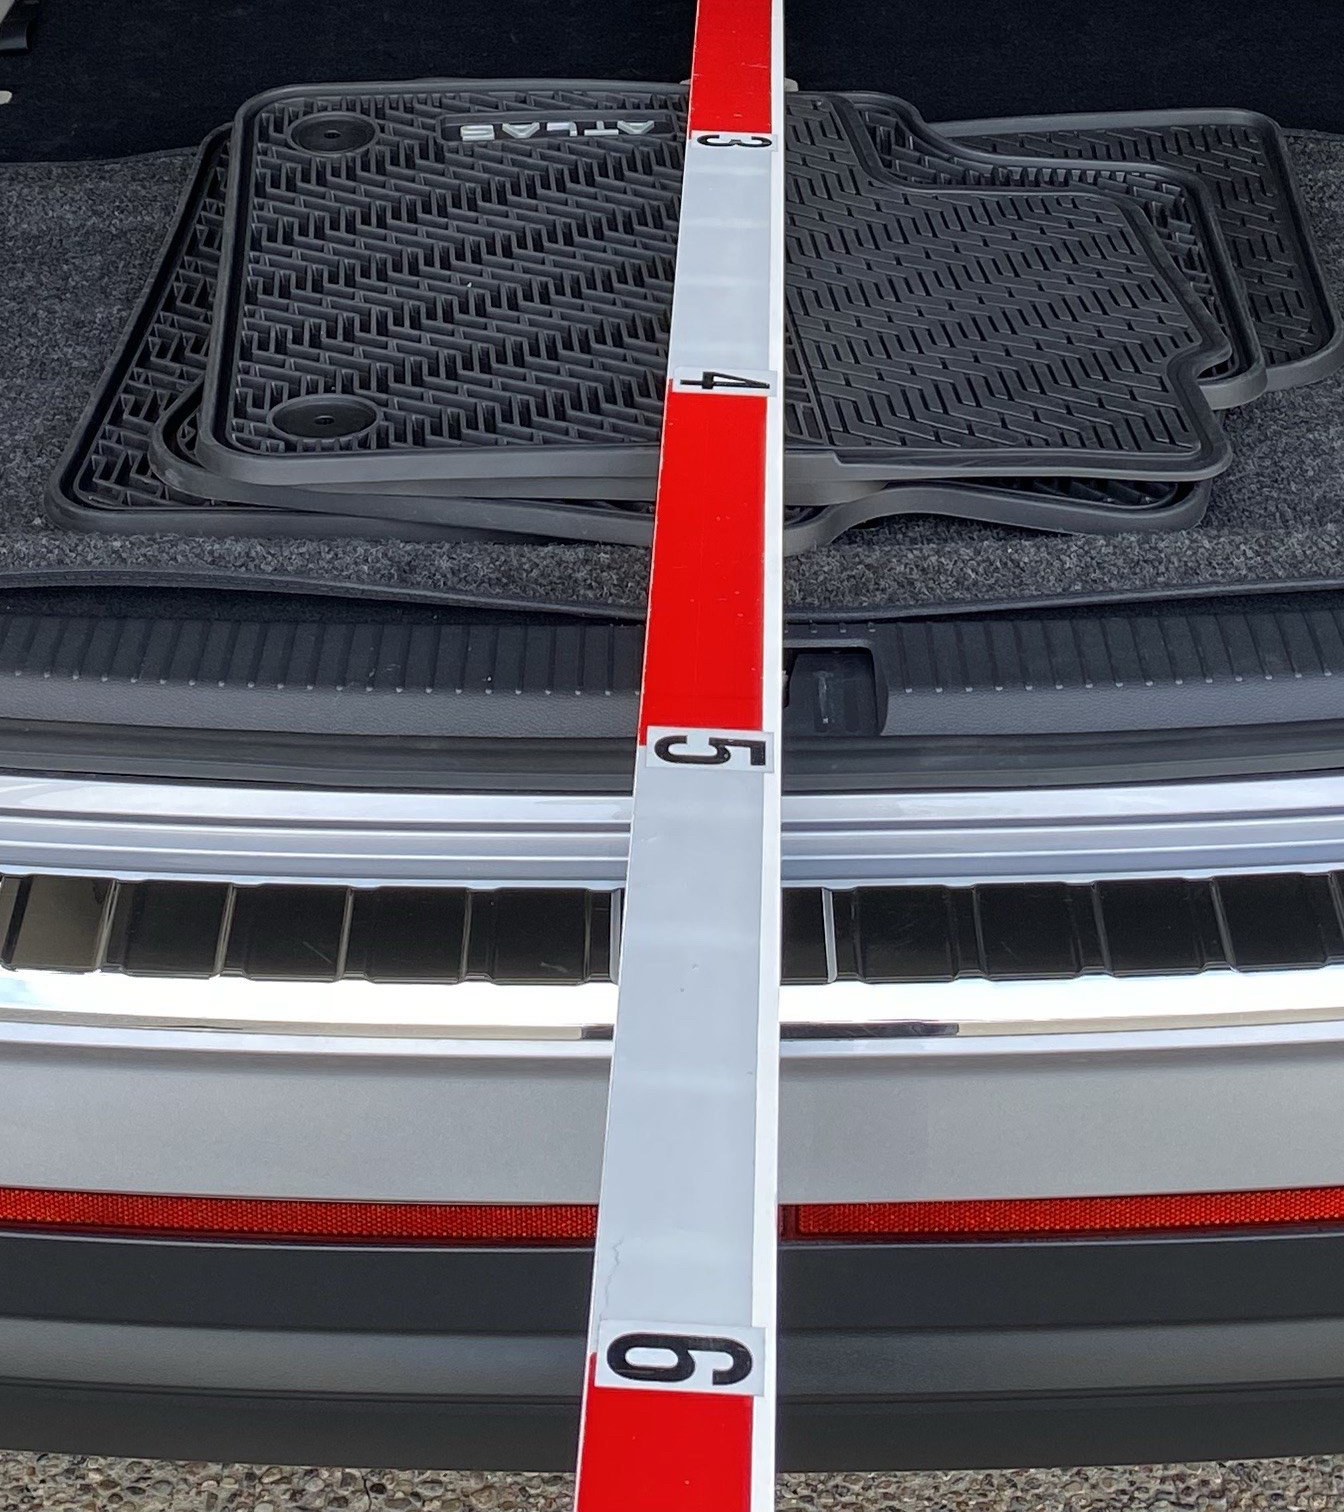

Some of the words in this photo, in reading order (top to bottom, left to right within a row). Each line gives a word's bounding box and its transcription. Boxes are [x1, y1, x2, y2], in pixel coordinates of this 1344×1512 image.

[460, 120, 655, 142] ATLAS
[697, 134, 773, 148] 3
[680, 371, 771, 390] 4
[654, 734, 767, 767] 5
[606, 1332, 754, 1386] 6
